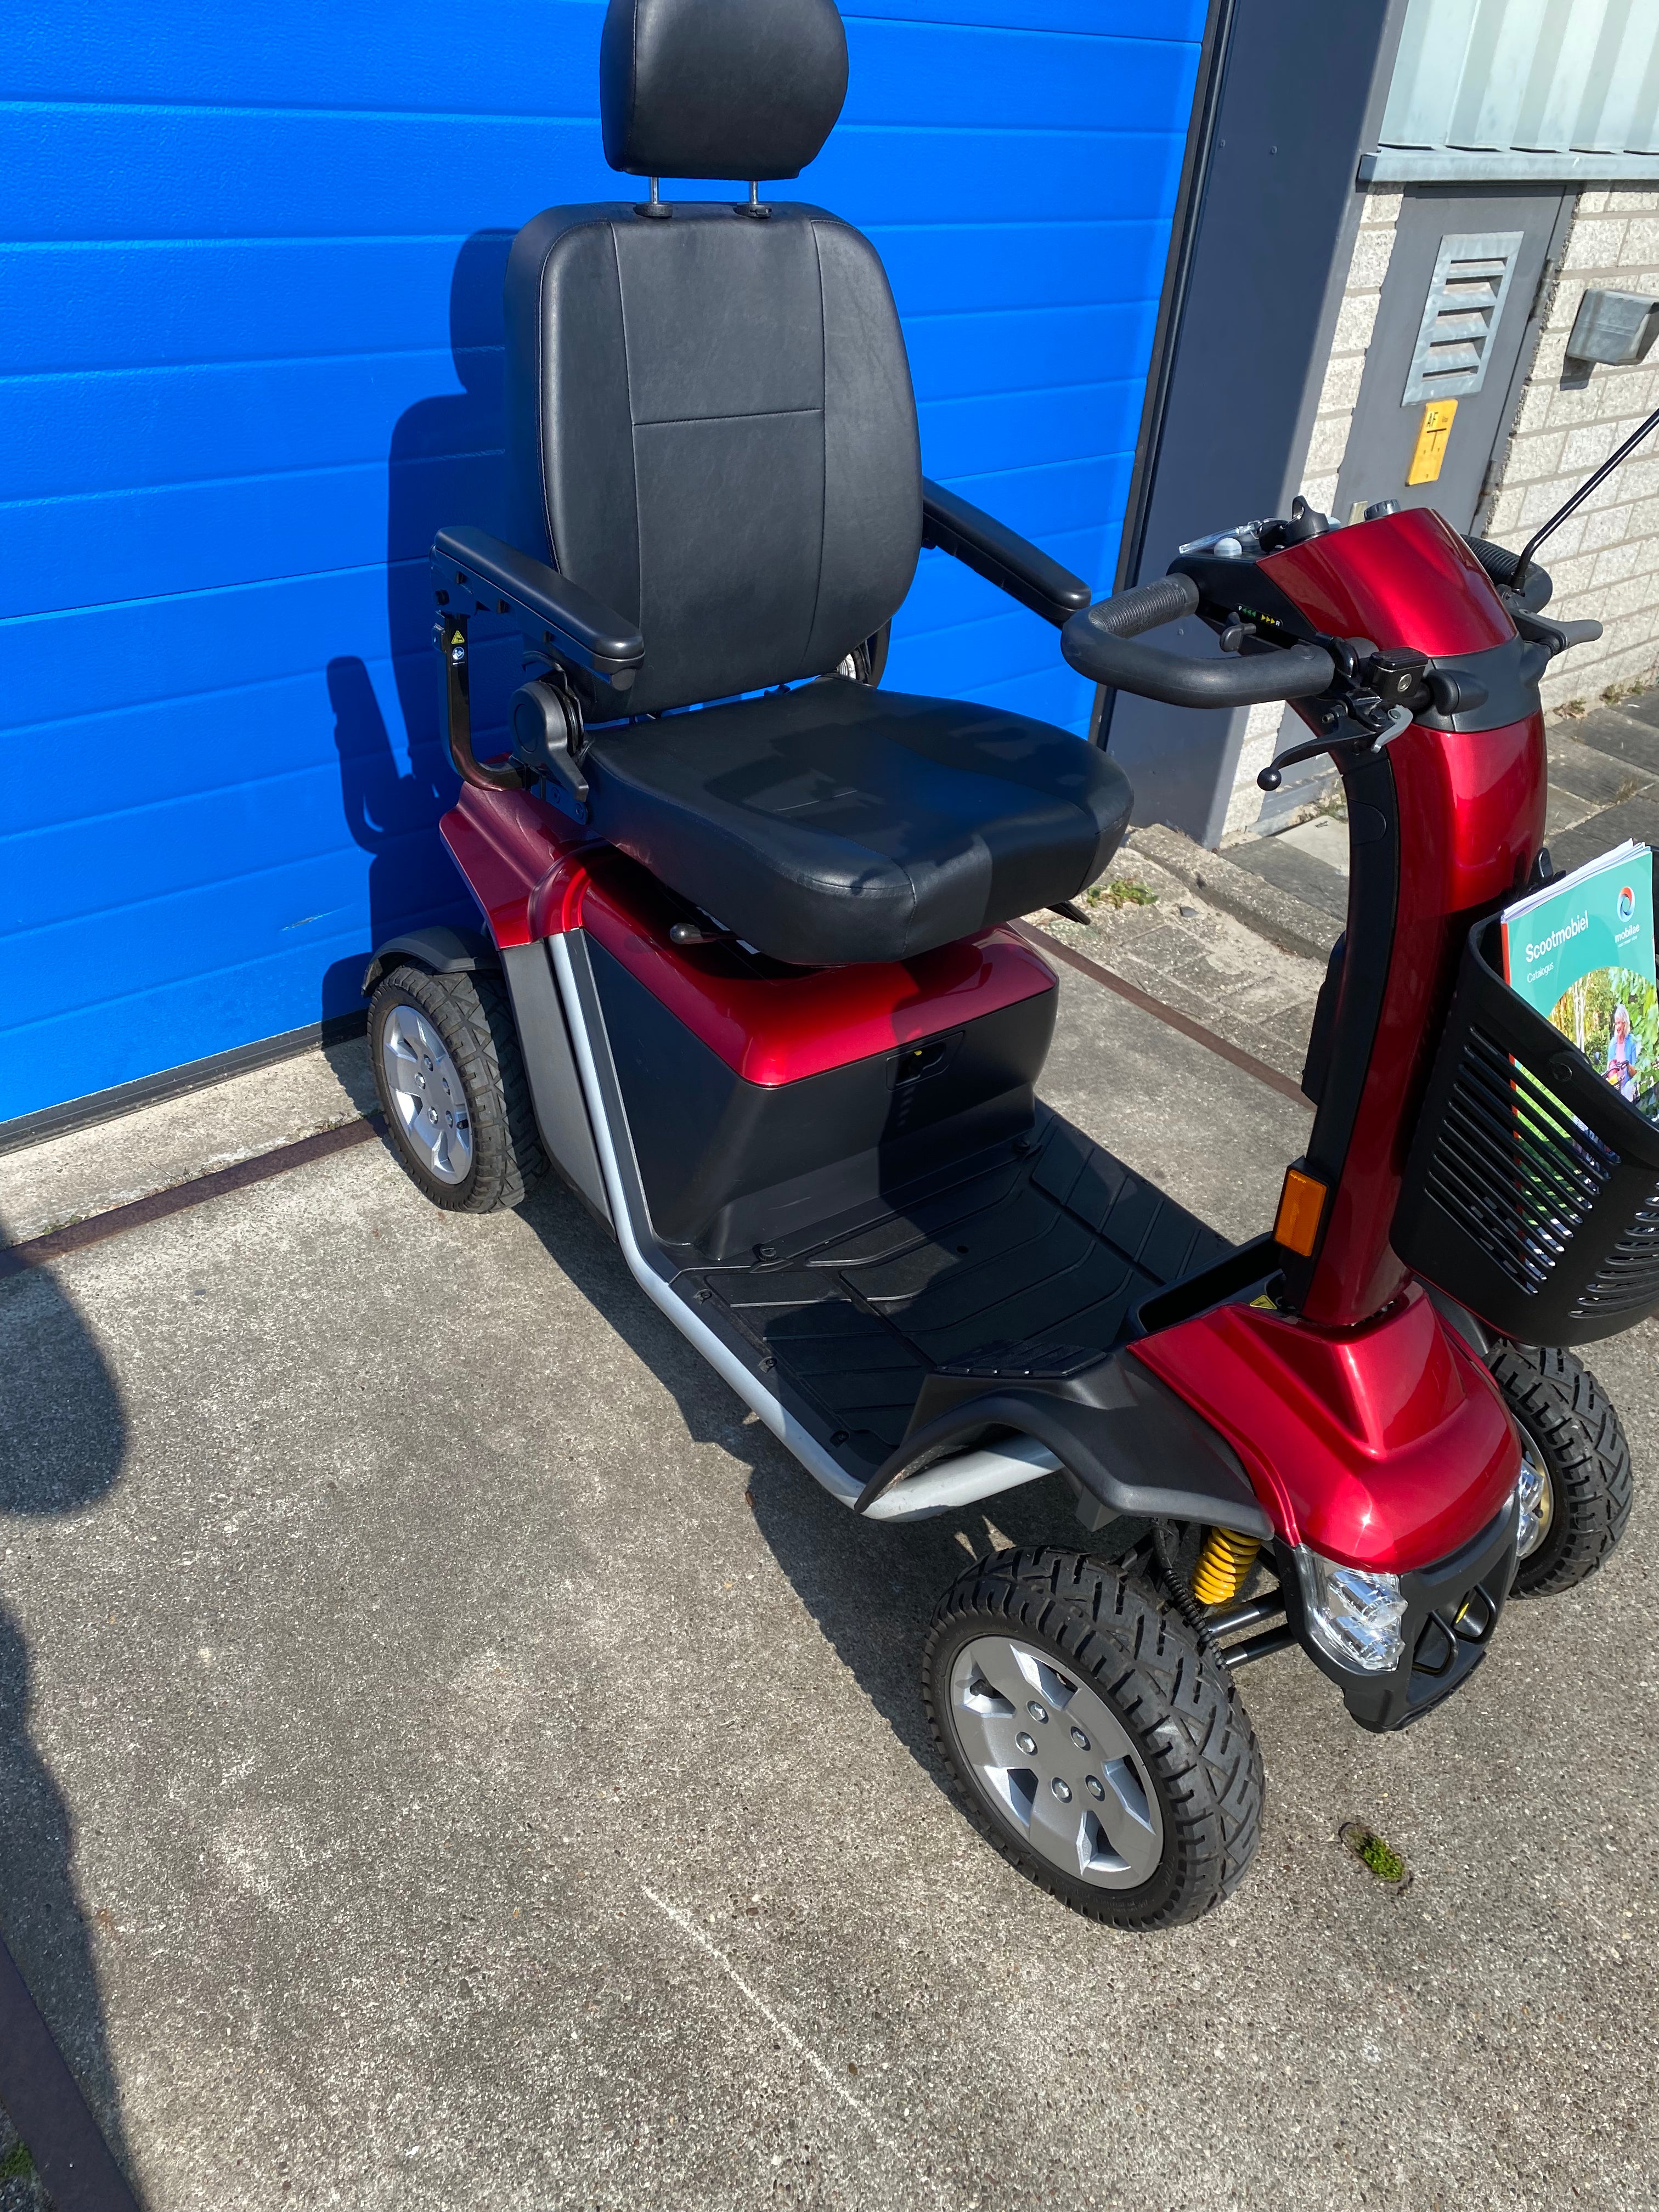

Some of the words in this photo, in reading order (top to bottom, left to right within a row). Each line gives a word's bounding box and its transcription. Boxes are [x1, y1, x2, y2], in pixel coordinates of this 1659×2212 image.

[1526, 910, 1588, 962] Scootmobiel
[1615, 924, 1640, 943] mobilae
[1527, 962, 1554, 983] Catalogus
